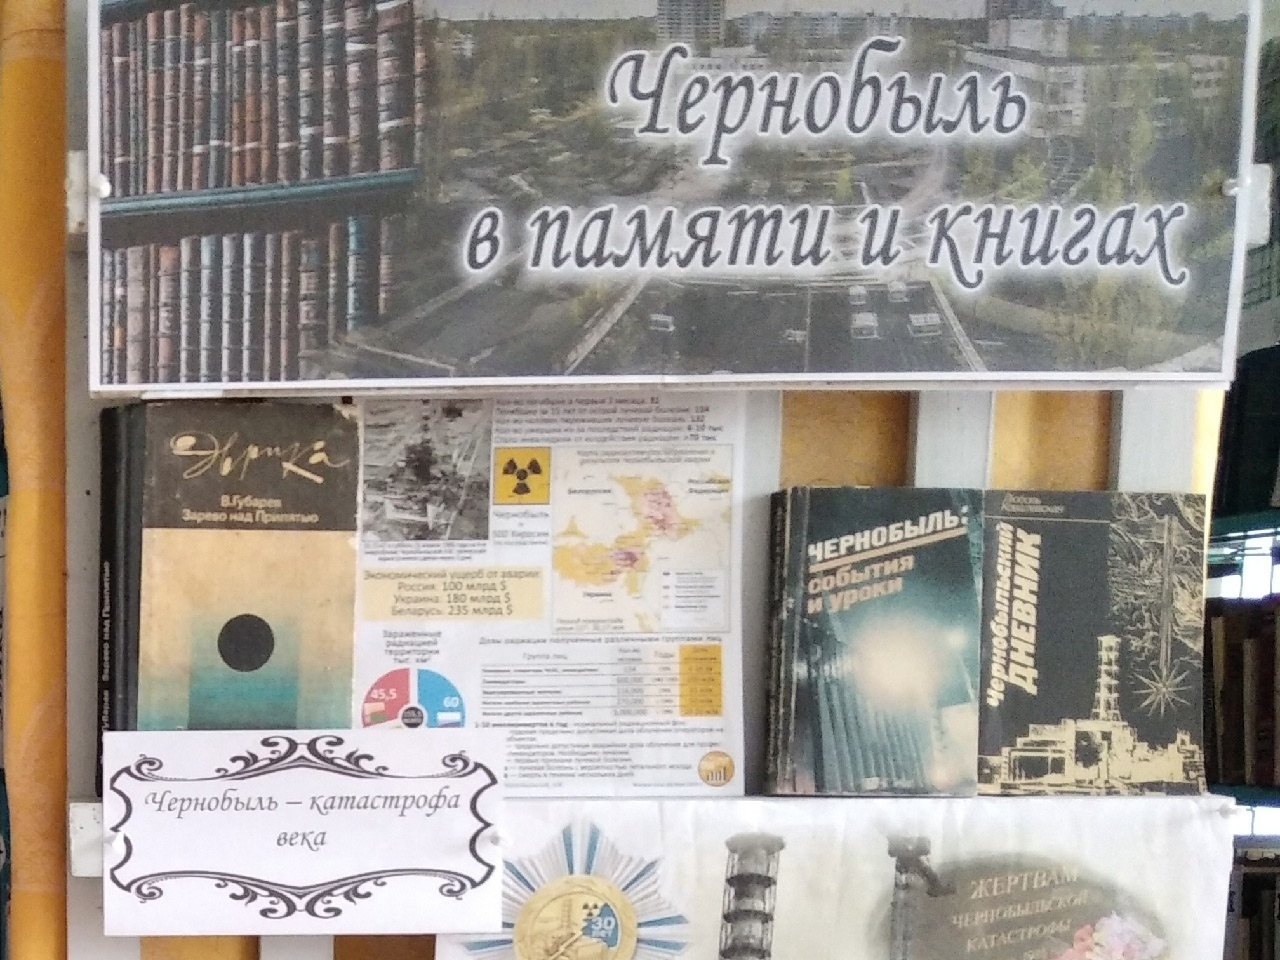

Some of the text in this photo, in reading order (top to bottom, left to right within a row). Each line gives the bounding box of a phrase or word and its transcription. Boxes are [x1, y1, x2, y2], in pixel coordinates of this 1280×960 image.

[607, 38, 1028, 165] Чернобыль
[467, 200, 1187, 287] в памяти и книгах
[229, 512, 254, 522] над
[808, 504, 969, 562] ЧЕРНОБЫЛЬ:
[443, 582, 462, 591] 100
[466, 583, 497, 592] млрд
[808, 553, 915, 595] события
[446, 594, 466, 603] 180
[470, 595, 501, 604] млрд
[808, 576, 903, 614] и уроки
[448, 607, 468, 615] 235
[472, 607, 503, 616] млрд
[986, 521, 1013, 707] Чернобыльский
[1009, 528, 1041, 695] ДНЕВНИК
[370, 689, 397, 700] 45,5
[444, 697, 459, 707] 60
[145, 789, 278, 817] Чернобыль
[309, 787, 460, 817] катастрофа
[276, 827, 327, 849] века
[970, 865, 1077, 899] ЖЕРТВАМ
[591, 916, 616, 931] 30
[966, 919, 1071, 952] КАТАСТРОФЫ
